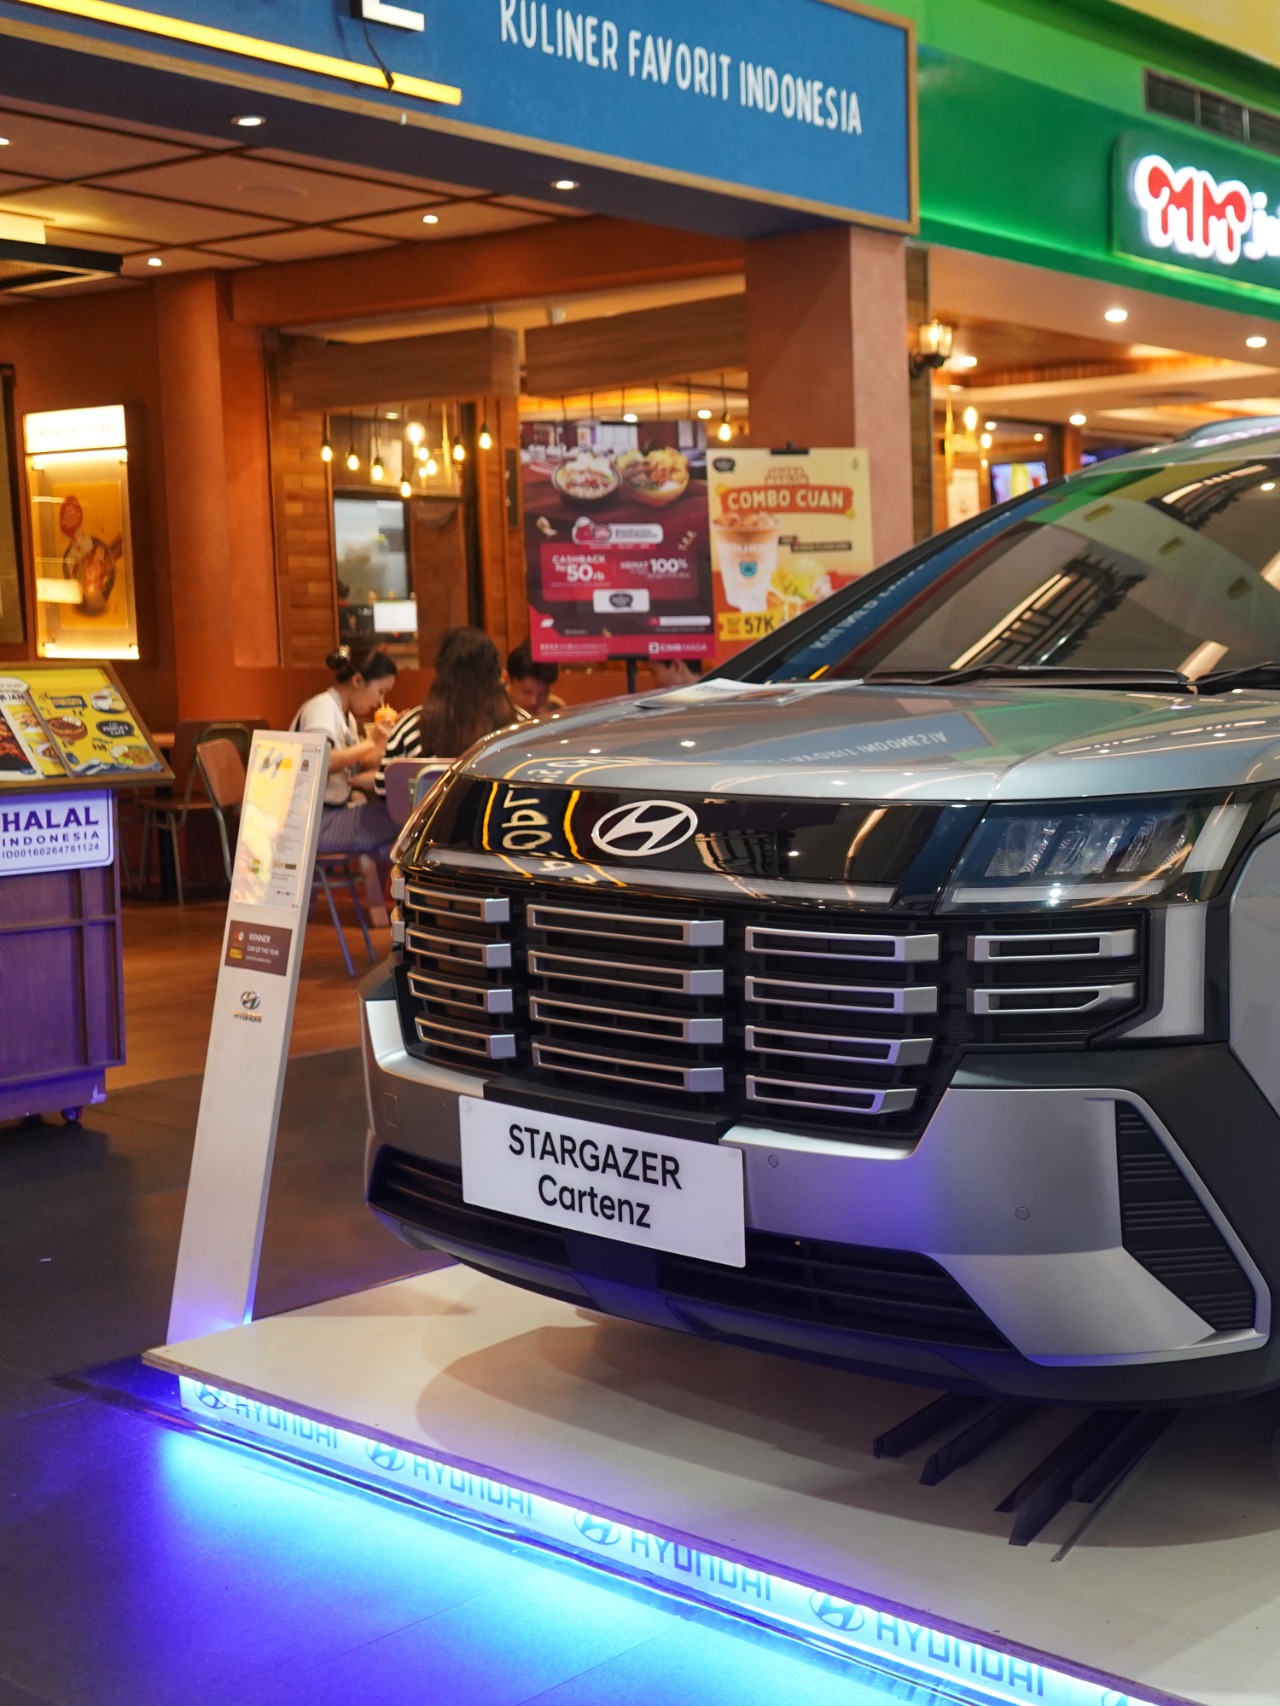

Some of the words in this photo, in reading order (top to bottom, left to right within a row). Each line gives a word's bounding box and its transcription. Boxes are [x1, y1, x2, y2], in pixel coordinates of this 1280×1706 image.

[500, 0, 618, 72] KULINER
[628, 30, 731, 100] FAVORIT
[740, 61, 862, 135] INDONESIA
[728, 489, 790, 510] COMBO
[795, 489, 844, 508] CUAN
[744, 617, 776, 634] 57K
[2, 806, 99, 832] HALAL
[2, 831, 99, 847] INDONESIA
[508, 1123, 683, 1190] STARGAZER
[537, 1174, 651, 1229] Cartenz
[413, 1456, 532, 1517] HYUNDAI
[631, 1529, 771, 1601] HYUNDAI
[878, 1611, 1044, 1697] HYUNDAI
